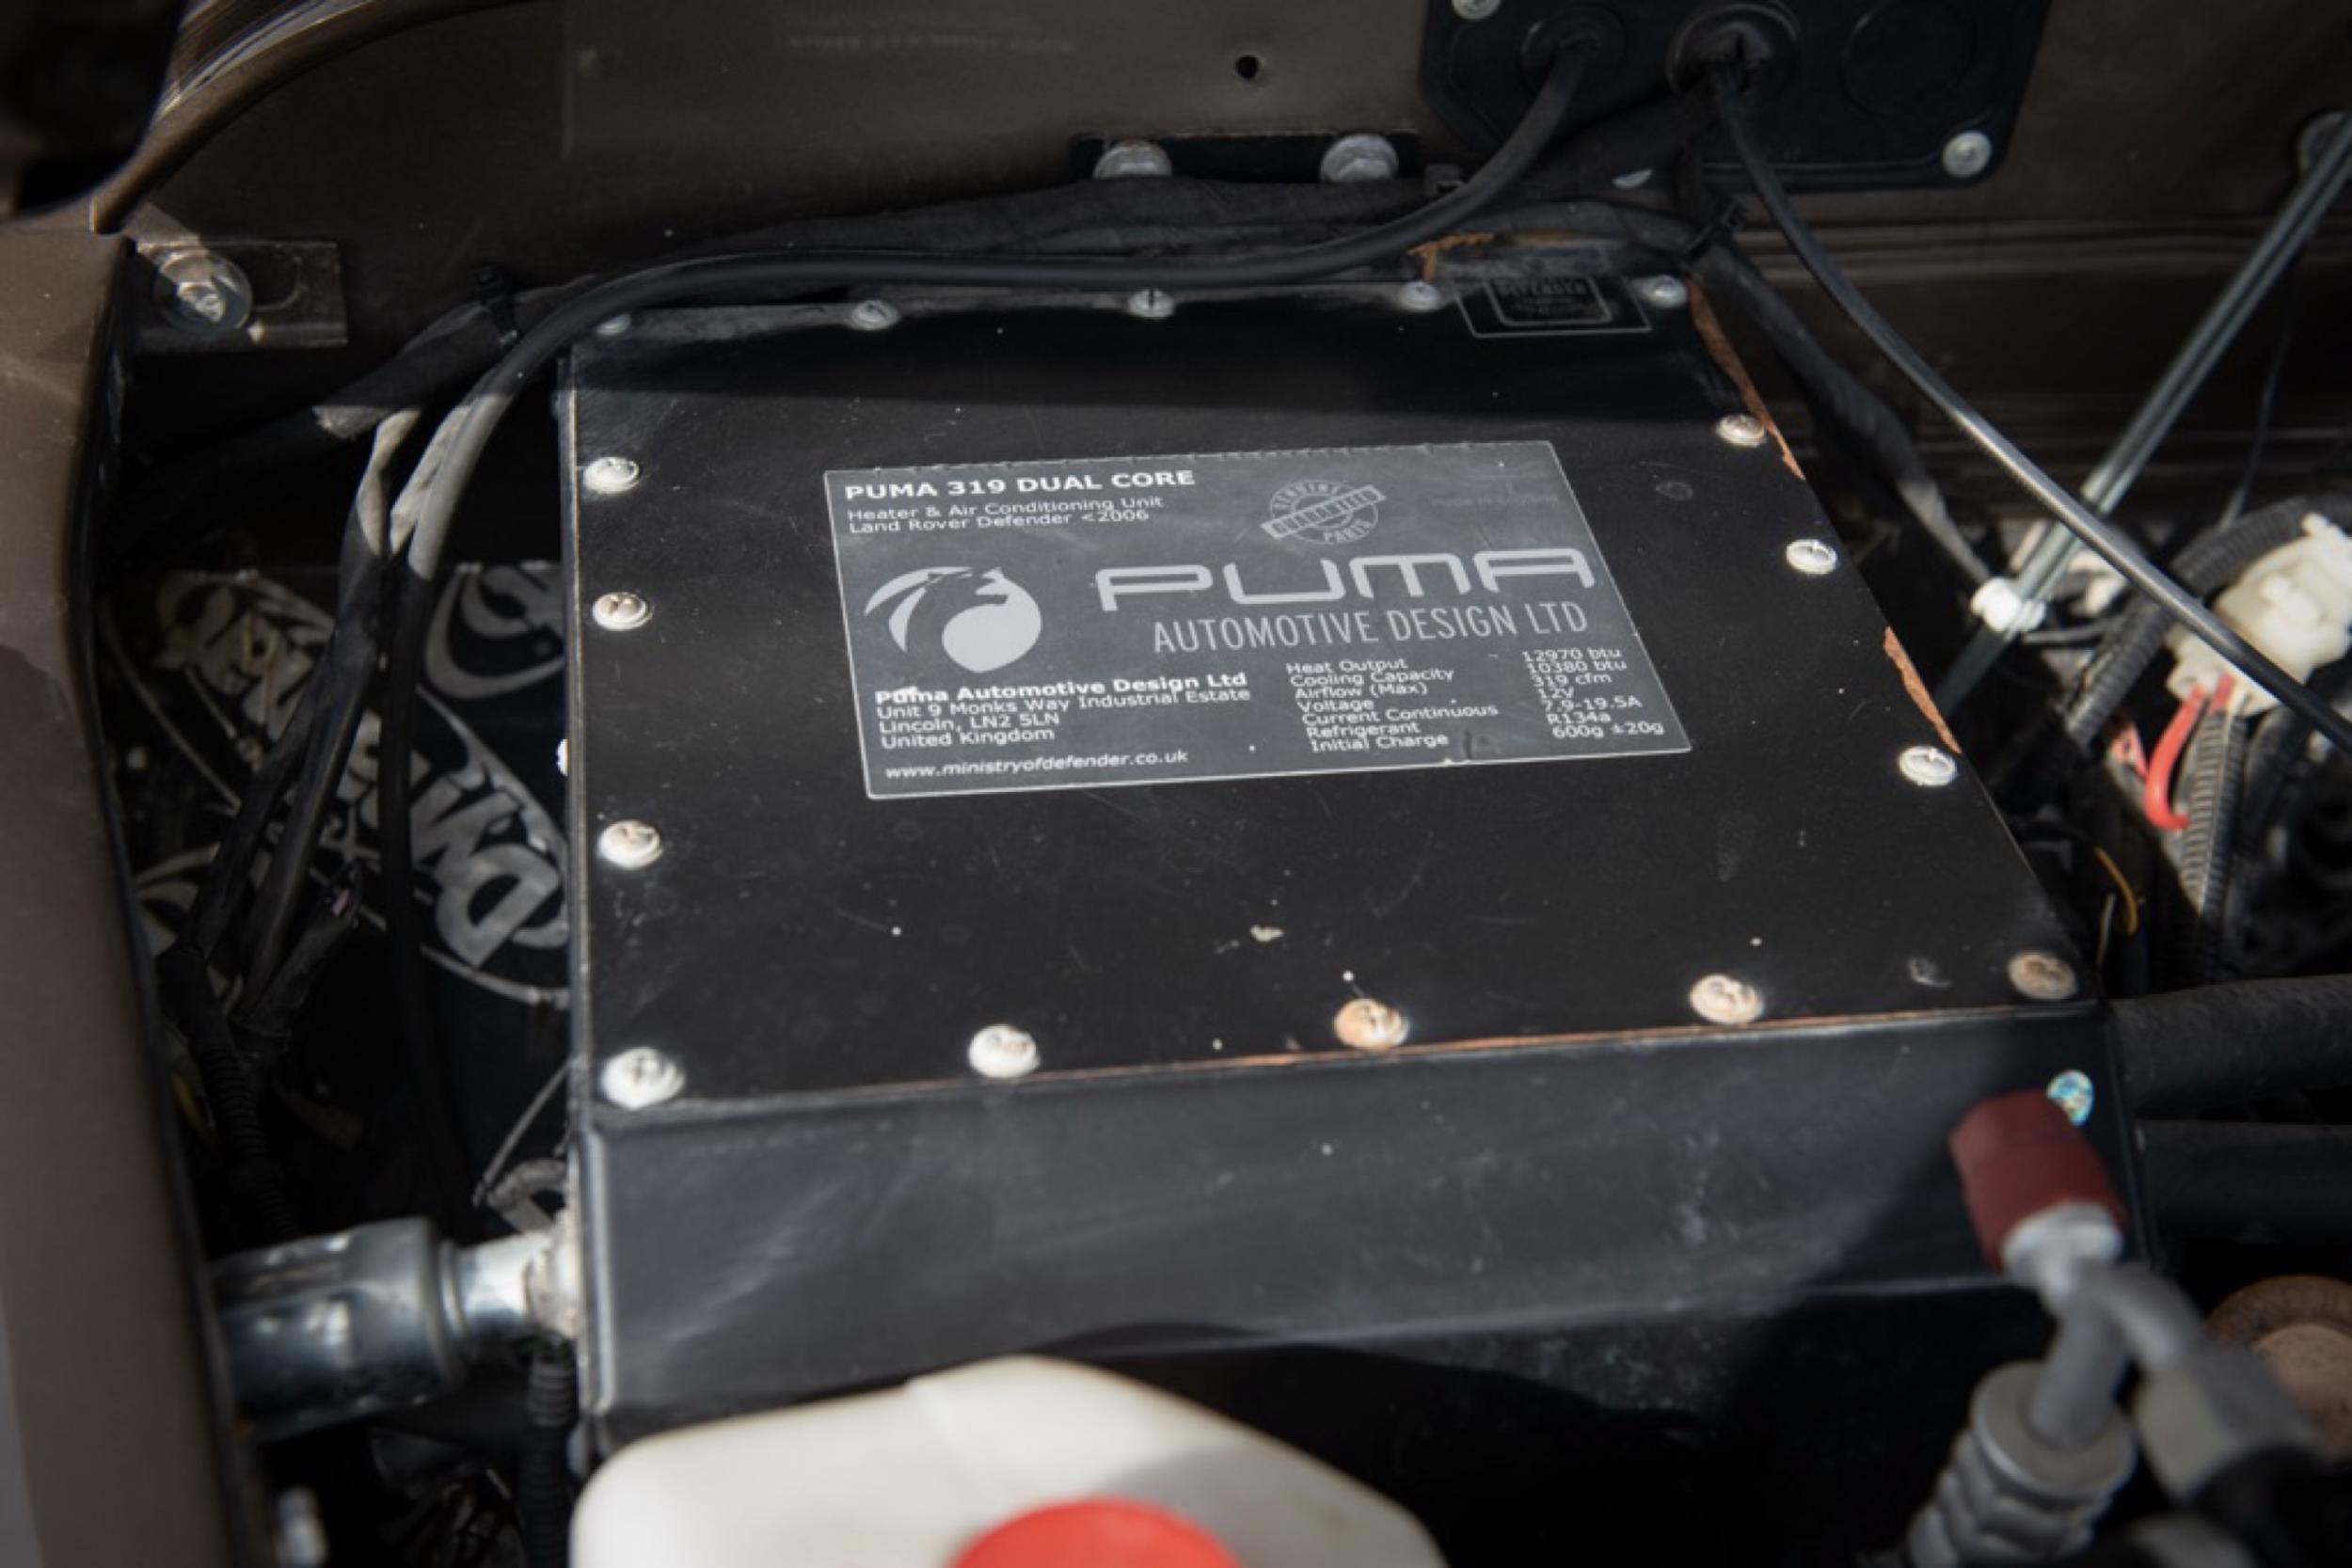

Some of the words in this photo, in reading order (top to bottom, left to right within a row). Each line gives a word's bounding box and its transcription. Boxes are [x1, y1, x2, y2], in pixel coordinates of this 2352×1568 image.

[845, 482, 938, 500] PUMA
[947, 479, 1007, 496] 319
[1016, 475, 1104, 493] DUAL
[1111, 470, 1196, 488] CORE
[847, 507, 919, 521] Heater
[925, 506, 942, 517] &
[948, 503, 978, 516] Air
[985, 499, 1115, 515] Conditioning
[1120, 496, 1165, 509] Unit
[850, 520, 900, 534] Land
[908, 517, 971, 531] Rover
[976, 514, 1072, 529] Defender
[1081, 509, 1150, 523] <2006
[1322, 519, 1373, 543] PARTS
[1095, 548, 1595, 611] PUMA
[1154, 611, 1379, 653] AUTOMOTIVE
[1387, 605, 1518, 641] DESIGN
[1524, 601, 1588, 635] LTD
[1522, 649, 1582, 662] 12970
[1587, 647, 1623, 659] btu
[1286, 661, 1332, 673] Heat
[1339, 658, 1408, 673] Output
[1527, 660, 1587, 674] 10380
[1594, 660, 1628, 672] btu
[1290, 673, 1364, 687] Cooling
[1370, 668, 1454, 683] Capacity
[1531, 674, 1569, 688] 319
[1575, 673, 1613, 686] cfm
[875, 689, 949, 704] Puma
[957, 680, 1105, 701] Automotive
[1113, 675, 1200, 693] Design
[1206, 672, 1248, 689] Ltd
[1295, 686, 1362, 699] Airflow
[1369, 682, 1427, 698] (Max)
[1537, 687, 1575, 699] 12V
[877, 705, 921, 720] Unit
[928, 704, 942, 717] 9
[950, 701, 1018, 716] Monks
[1025, 698, 1069, 712] Way
[1078, 692, 1179, 709] Industrial
[1185, 689, 1250, 704] Estate
[1297, 699, 1375, 713] Voltage
[1541, 695, 1643, 712] 7.9-19.5A
[880, 718, 961, 734] Lincoln,
[970, 715, 1011, 729] LN2
[1302, 711, 1381, 726] Current
[1385, 705, 1499, 721] Continuous
[1546, 711, 1612, 725] R134a
[881, 732, 952, 749] United
[960, 728, 1056, 745] Kingdom
[1306, 722, 1422, 739] Refrigerant
[1552, 724, 1604, 739] 600g
[1310, 737, 1370, 752] Initial
[1375, 735, 1449, 749] Charge
[885, 750, 1188, 779] www.ministryofdefender.co.uk
